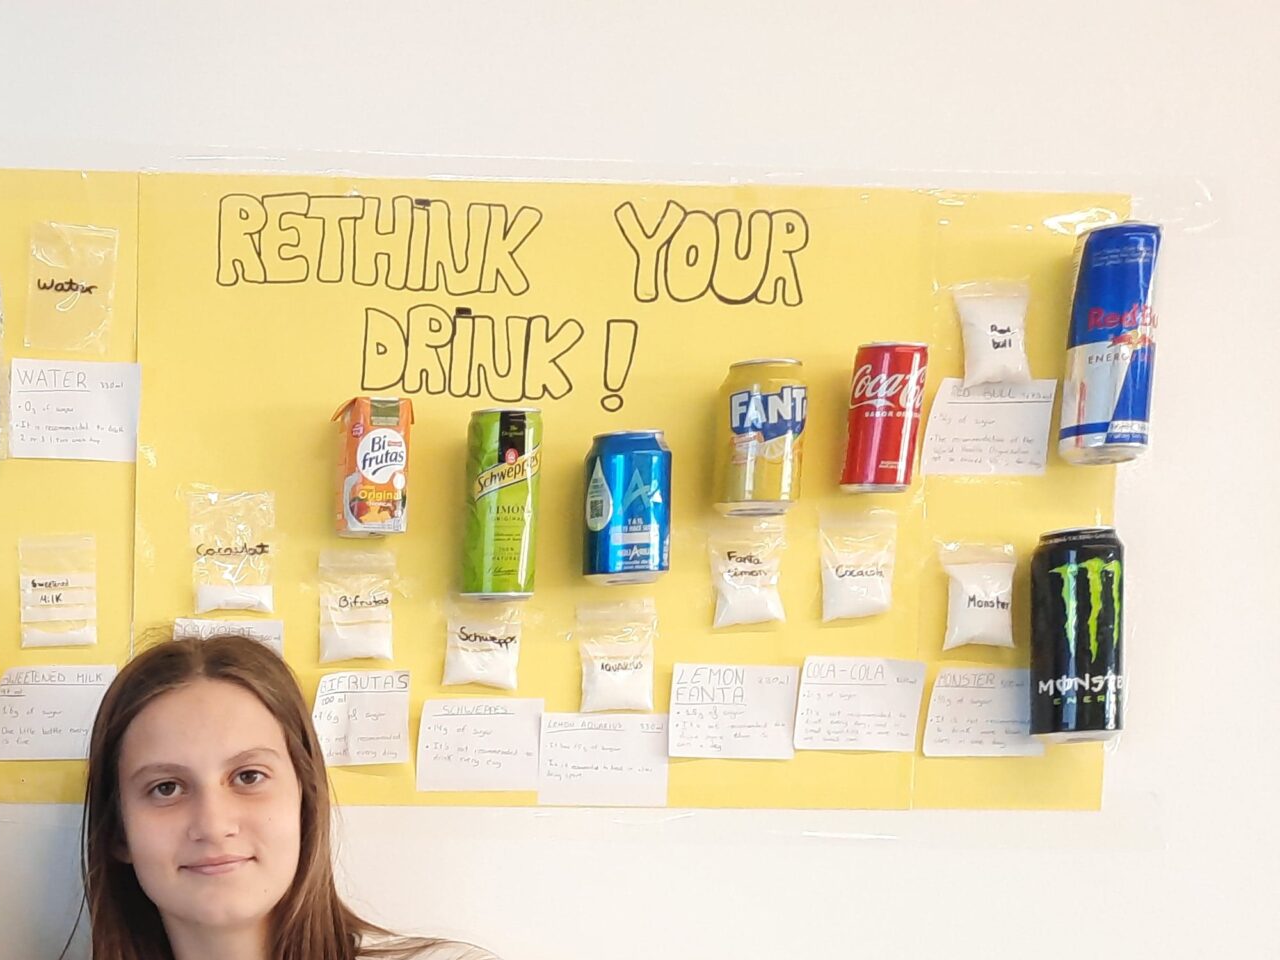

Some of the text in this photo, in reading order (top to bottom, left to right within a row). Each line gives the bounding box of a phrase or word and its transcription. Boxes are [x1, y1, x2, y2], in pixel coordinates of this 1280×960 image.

[614, 199, 810, 306] YOUR
[1087, 303, 1139, 332] Red
[991, 337, 1012, 350] bull
[16, 368, 88, 389] WATER
[370, 434, 388, 453] Bi
[360, 450, 406, 472] frutas
[726, 550, 764, 565] Fanta
[338, 594, 390, 609] Bifrutas
[966, 593, 1011, 610] Monster
[76, 672, 103, 684] MILK
[320, 673, 410, 694] BIFRUTAS
[676, 666, 745, 686] LEMON
[676, 685, 745, 704] FANTA
